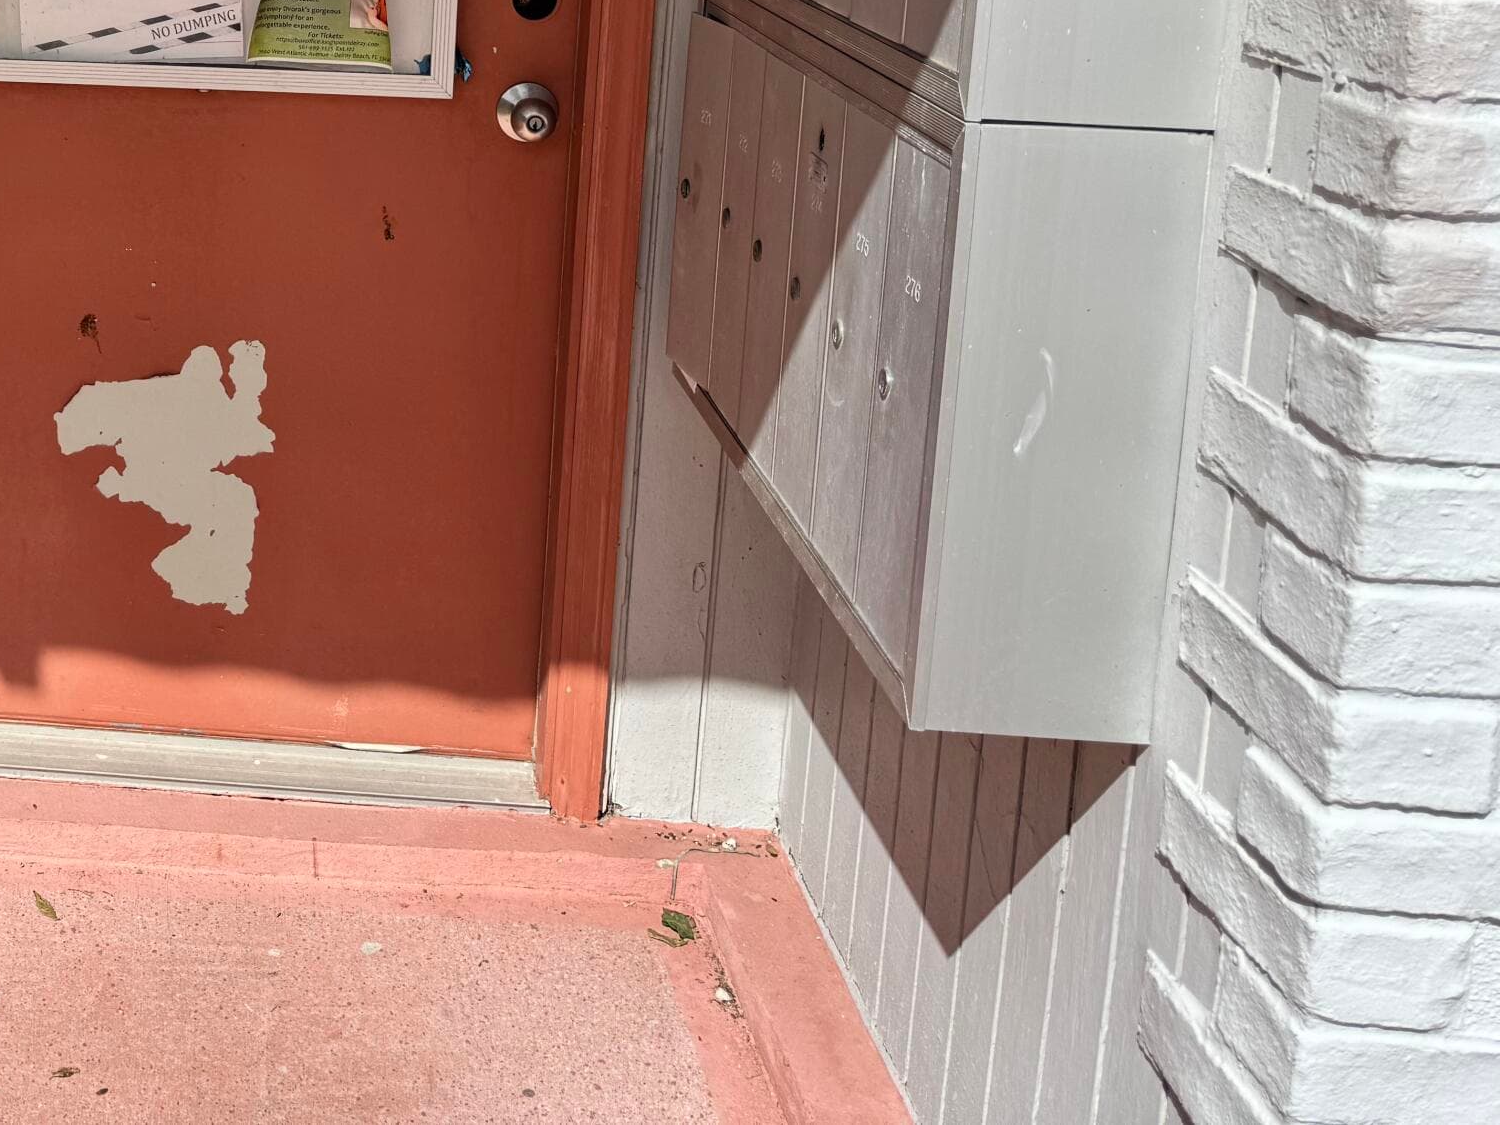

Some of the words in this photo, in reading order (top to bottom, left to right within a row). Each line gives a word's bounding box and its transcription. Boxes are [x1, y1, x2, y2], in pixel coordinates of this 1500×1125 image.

[152, 25, 171, 41] NO
[173, 9, 237, 35] DUMPING
[856, 232, 870, 257] 275
[905, 275, 921, 303] 276
